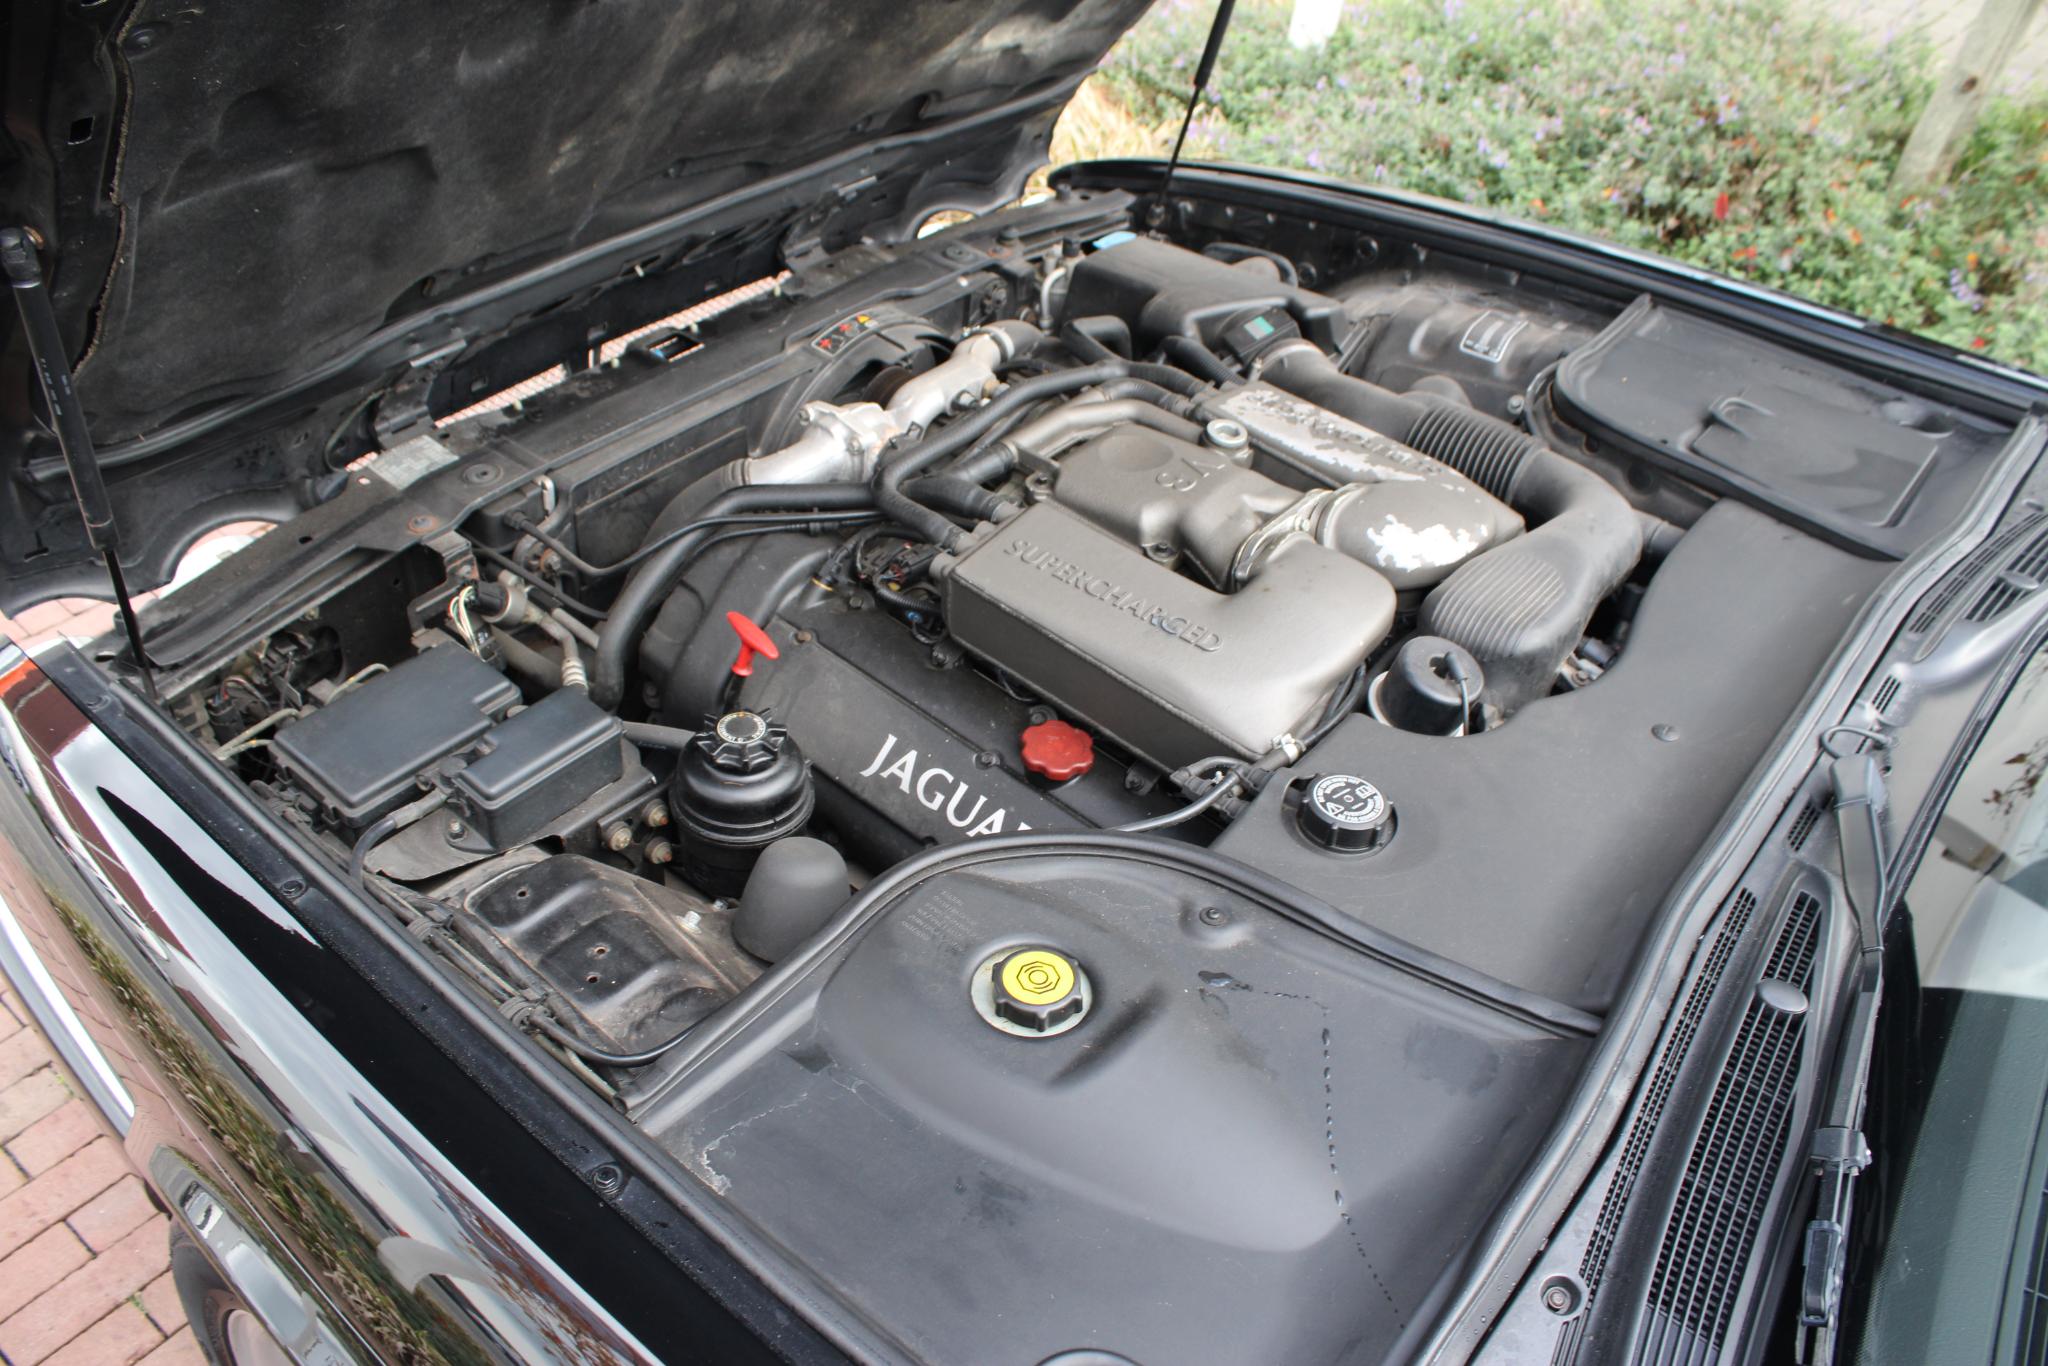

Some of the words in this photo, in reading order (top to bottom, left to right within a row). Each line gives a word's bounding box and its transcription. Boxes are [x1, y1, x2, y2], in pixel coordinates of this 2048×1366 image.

[1155, 456, 1226, 492] V8
[1003, 538, 1225, 653] SUPERCHARGED
[859, 732, 1033, 838] JAGUA
